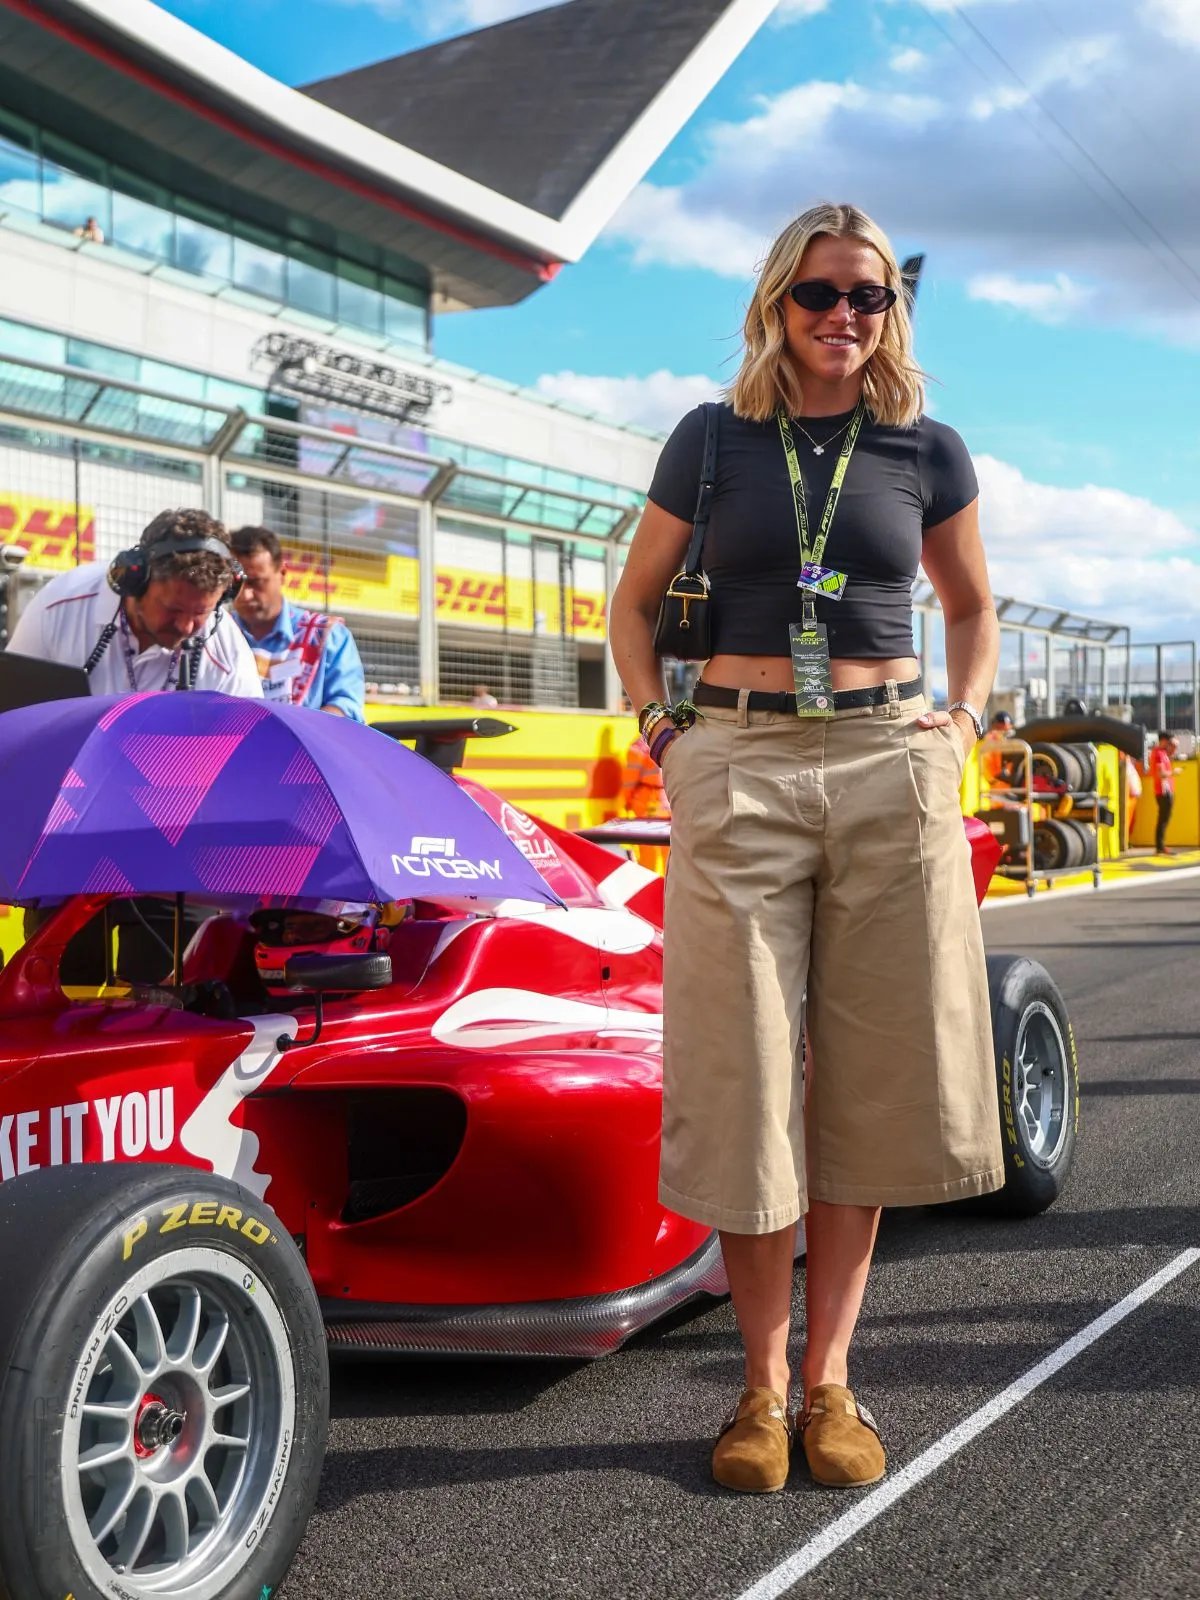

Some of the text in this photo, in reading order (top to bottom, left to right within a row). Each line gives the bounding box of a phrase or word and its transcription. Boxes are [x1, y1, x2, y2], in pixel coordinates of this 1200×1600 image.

[812, 537, 823, 563] TURDAY
[391, 854, 502, 880] ACADEMY
[50, 1101, 89, 1166] IT
[93, 1086, 174, 1162] YOU
[1002, 1056, 1018, 1145] ZERO
[122, 1201, 271, 1261] P ZERO
[70, 1337, 101, 1420] RACING
[268, 1430, 291, 1506] RACING
